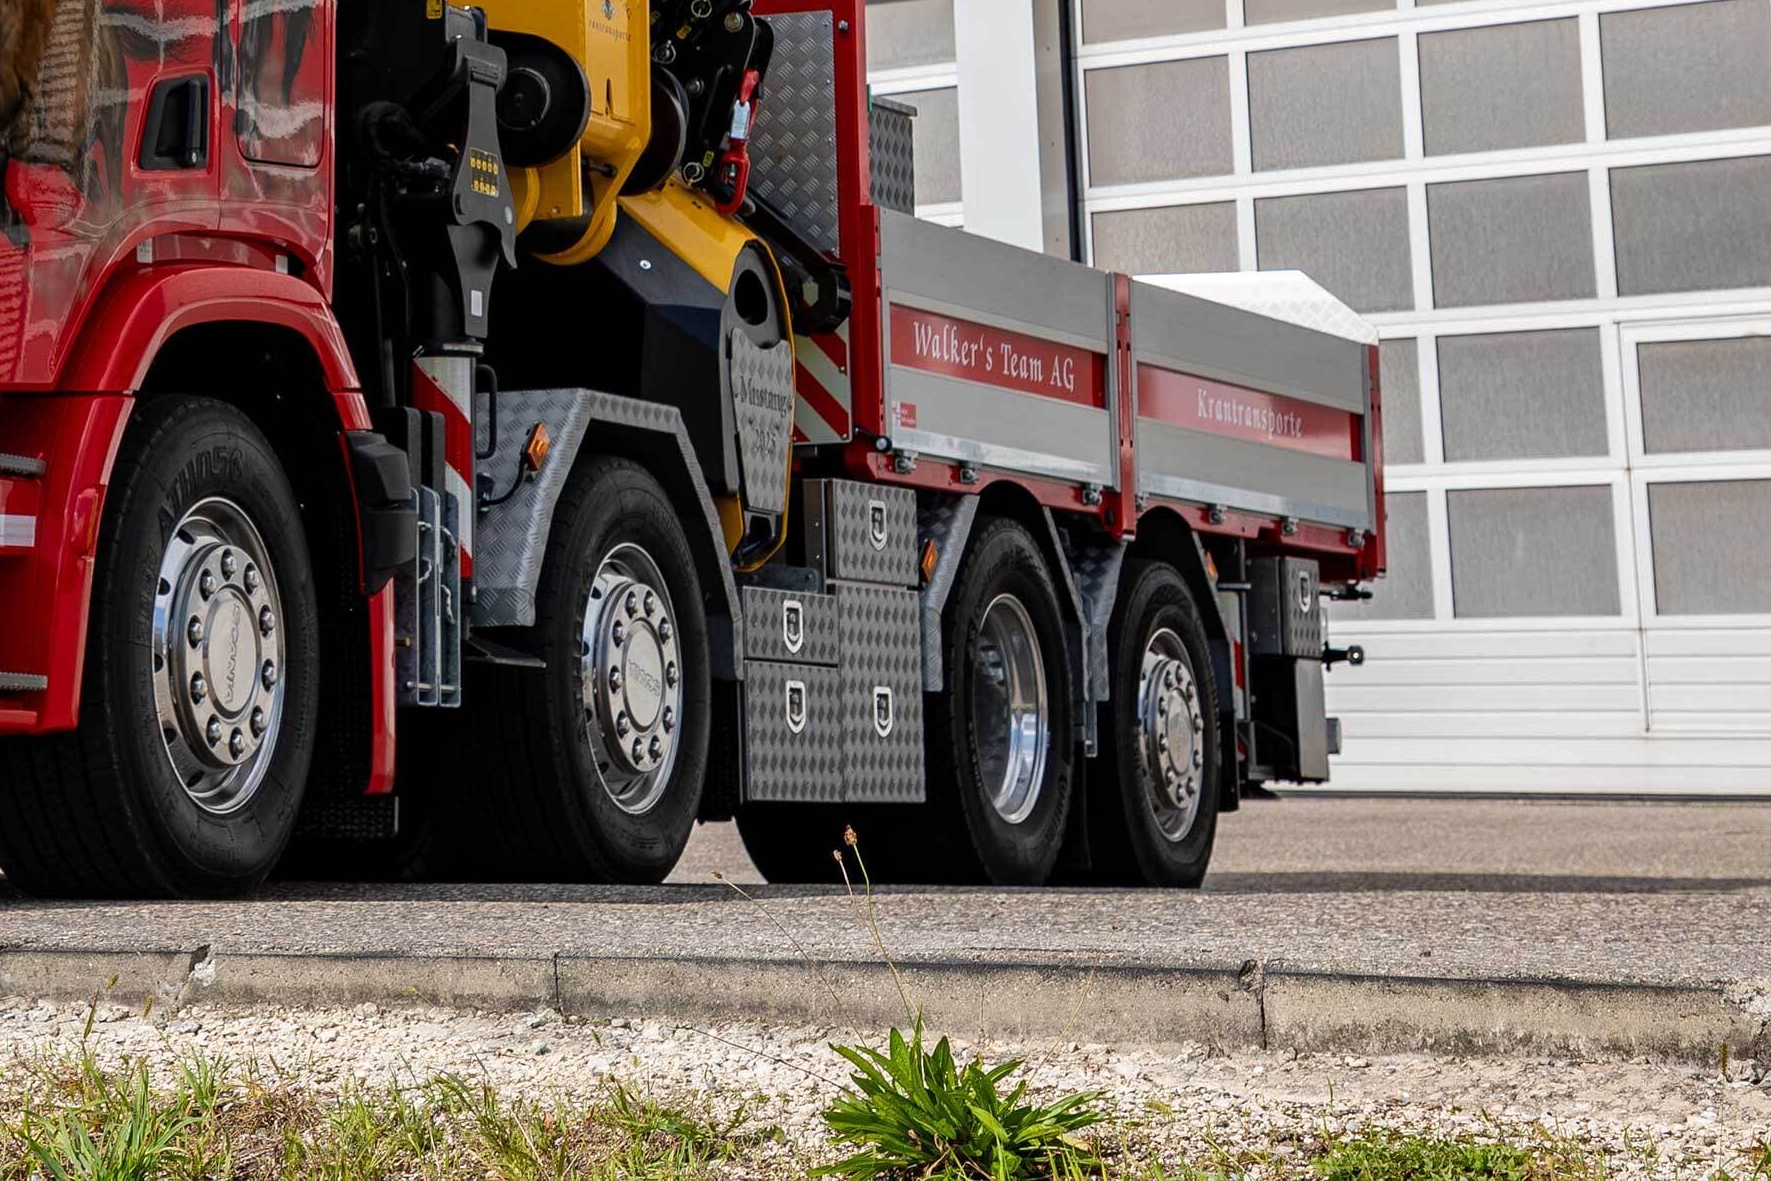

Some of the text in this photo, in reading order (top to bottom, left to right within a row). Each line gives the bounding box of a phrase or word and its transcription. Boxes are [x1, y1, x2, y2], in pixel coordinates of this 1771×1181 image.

[913, 321, 1075, 393] Walker's Team AG
[739, 375, 787, 419] Mustang
[1197, 387, 1302, 440] Krantransporte
